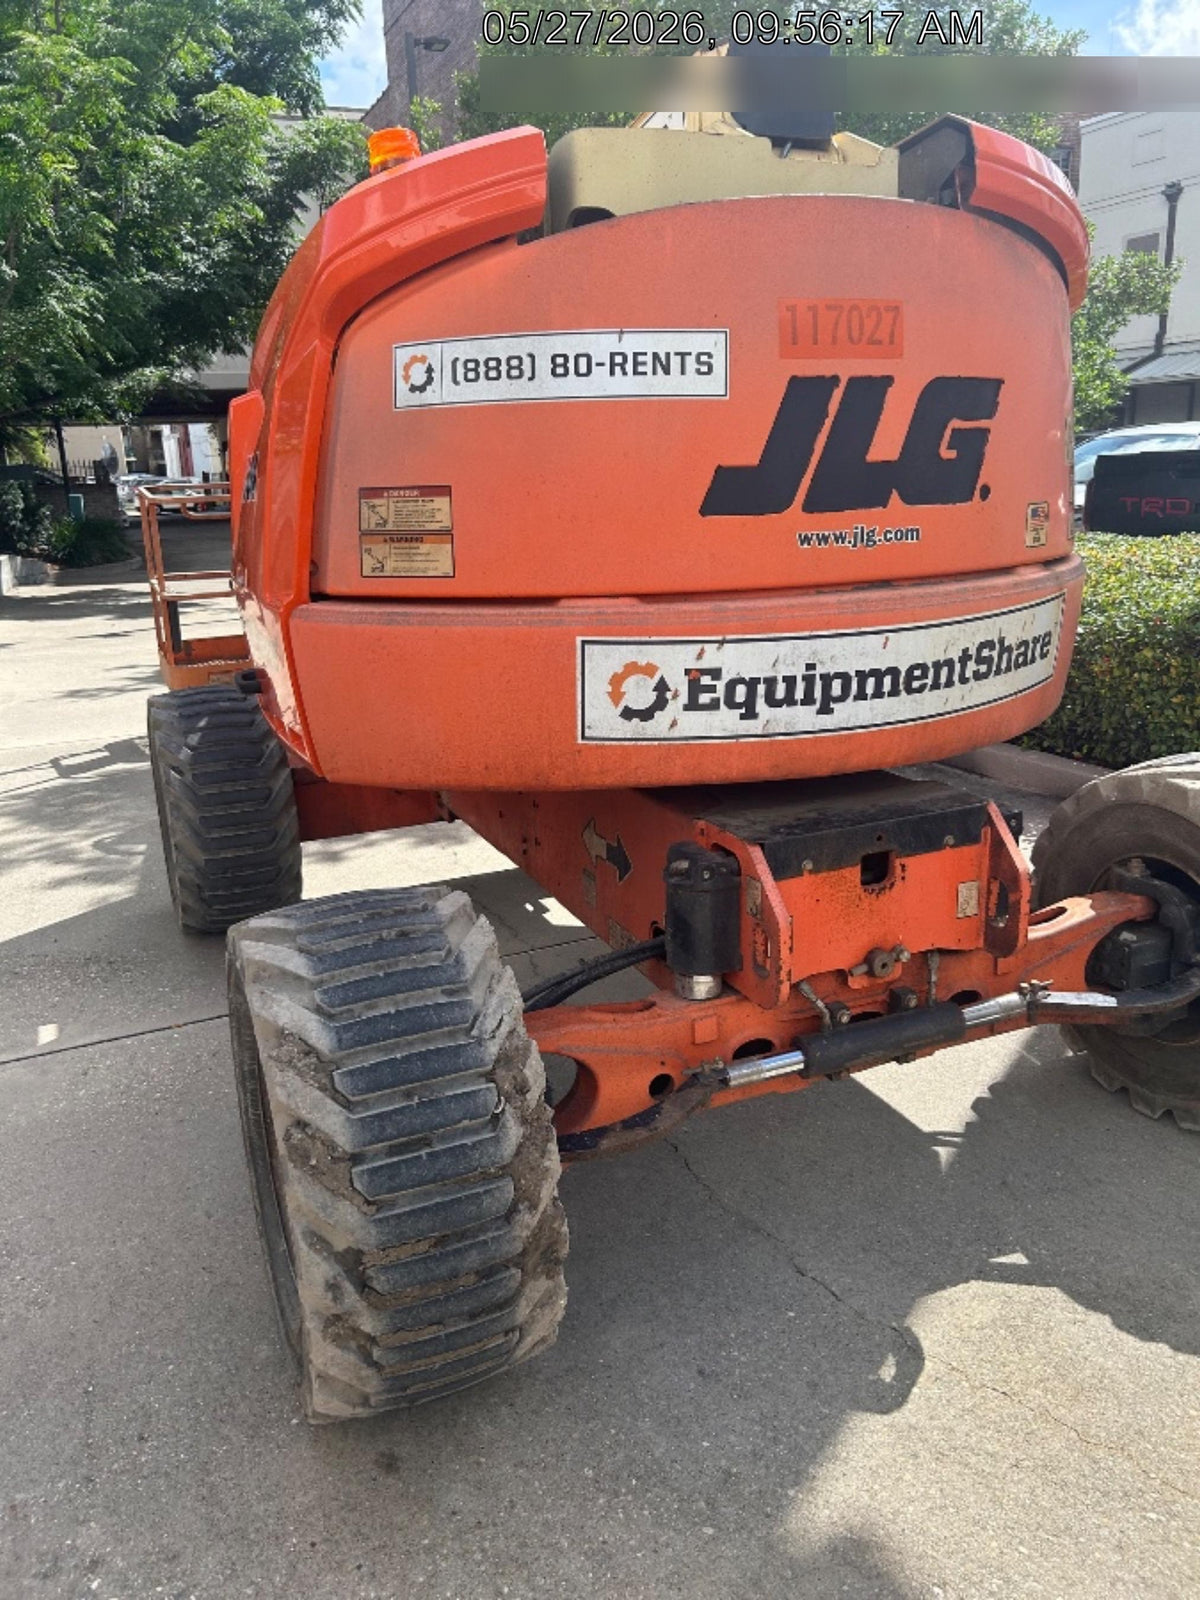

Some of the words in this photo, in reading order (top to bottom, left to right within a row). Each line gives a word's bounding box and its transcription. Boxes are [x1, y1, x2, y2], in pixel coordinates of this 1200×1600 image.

[785, 304, 900, 346] 117027
[451, 353, 535, 386] (888)
[550, 351, 714, 378] 80-RENTS
[1119, 496, 1193, 519] TRD
[797, 525, 921, 548] www.jlg.com
[683, 627, 1053, 721] EquipmentShare
